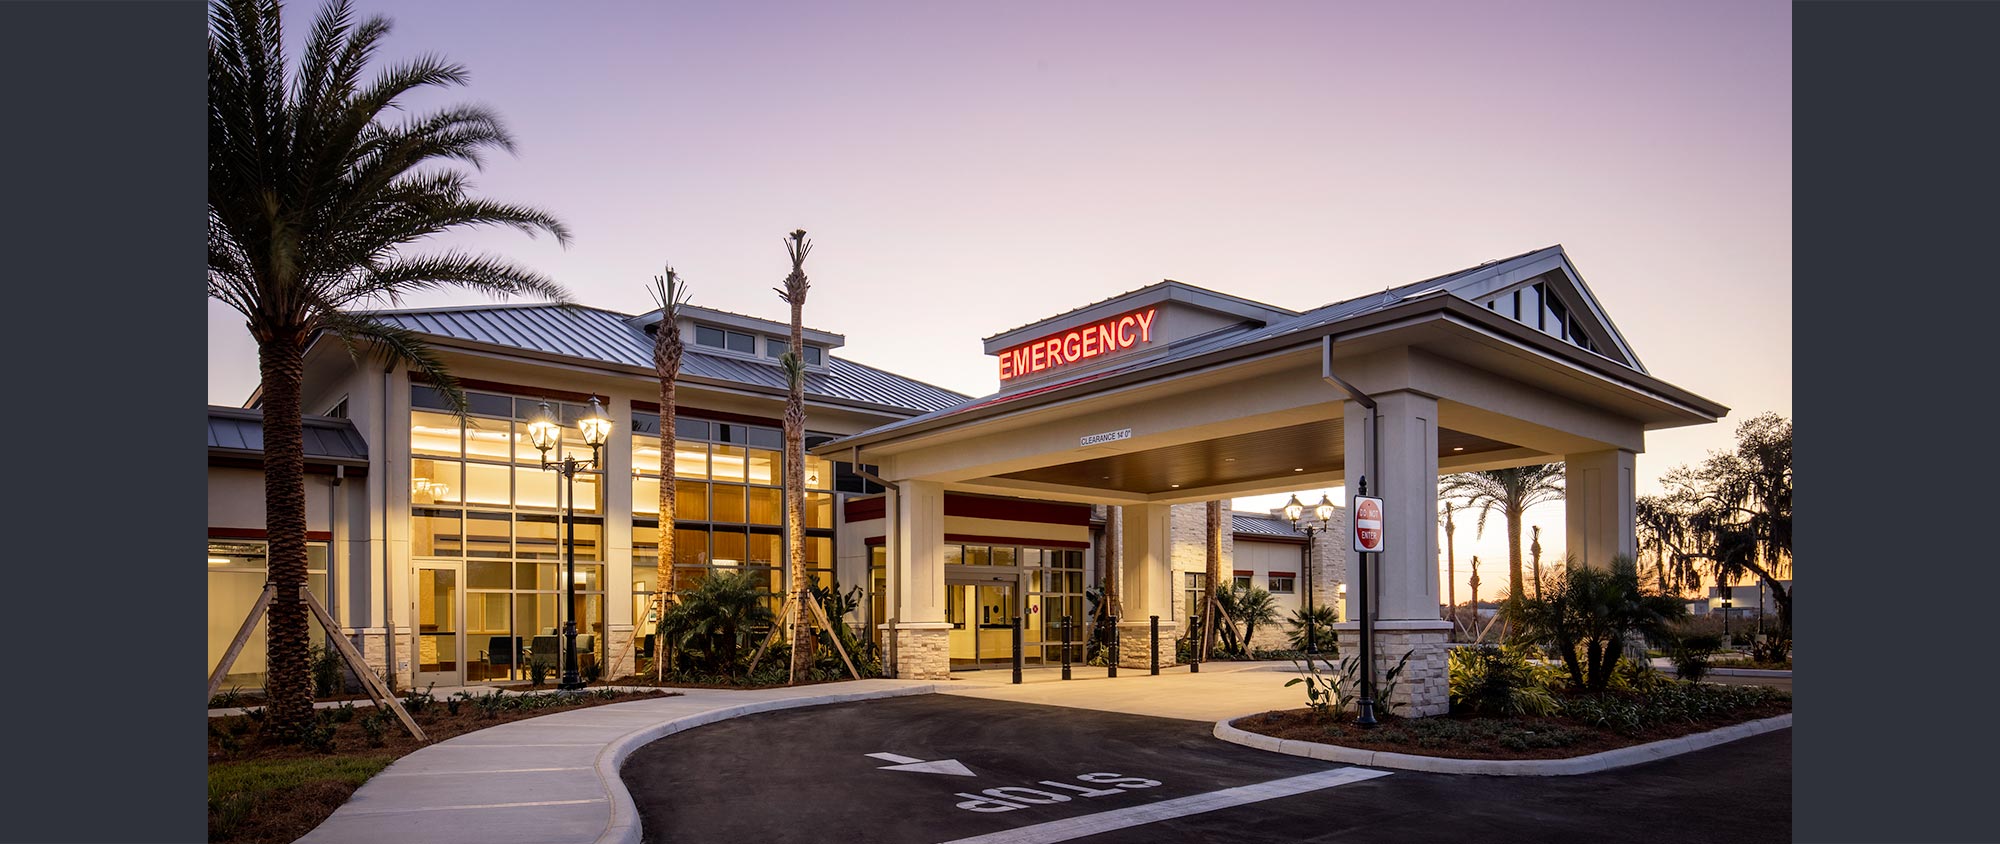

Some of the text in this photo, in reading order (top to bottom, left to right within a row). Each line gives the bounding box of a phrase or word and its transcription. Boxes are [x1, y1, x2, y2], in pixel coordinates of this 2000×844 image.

[1000, 309, 1156, 381] EMERGENCY
[1081, 432, 1116, 446] CLEARANCE
[1360, 508, 1379, 518] DO NOT
[1362, 531, 1377, 540] ENTER
[954, 772, 1163, 813] STOP
